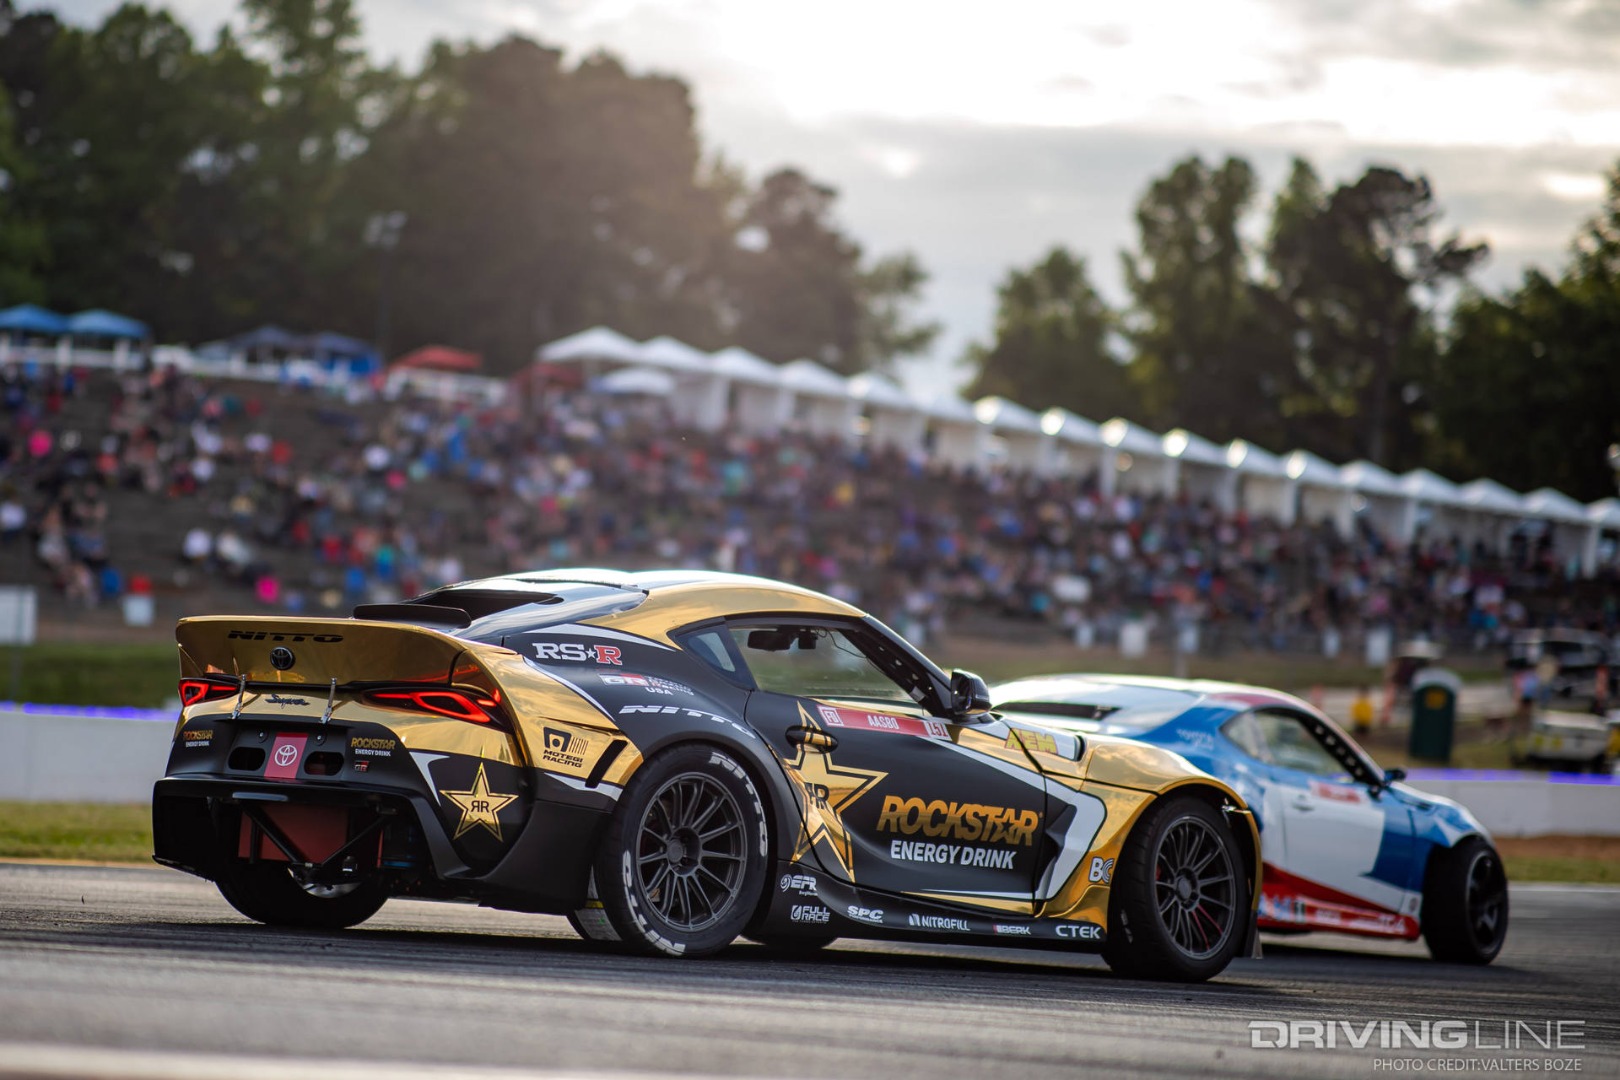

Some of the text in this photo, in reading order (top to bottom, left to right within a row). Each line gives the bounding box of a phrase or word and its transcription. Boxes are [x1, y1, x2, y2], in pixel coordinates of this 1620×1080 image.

[227, 630, 344, 643] NITTO
[645, 686, 674, 696] USA
[618, 705, 756, 739] NITTO
[867, 714, 899, 730] AASBO
[928, 721, 948, 737] 151
[351, 737, 396, 750] ROCKSTAR
[1004, 727, 1058, 755] AEM
[355, 748, 391, 757] ENERGY DRINK
[543, 749, 583, 763] MOTEGI
[542, 755, 582, 768] RACING
[876, 795, 1039, 847] ROCKSTAR
[890, 839, 1017, 870] ENERGY DRINK
[801, 912, 831, 922] RACE
[802, 905, 828, 915] FULL
[847, 905, 884, 920] SPC
[921, 914, 971, 932] NITROFILL
[1001, 925, 1032, 935] BERK
[1055, 924, 1101, 940] CTEK
